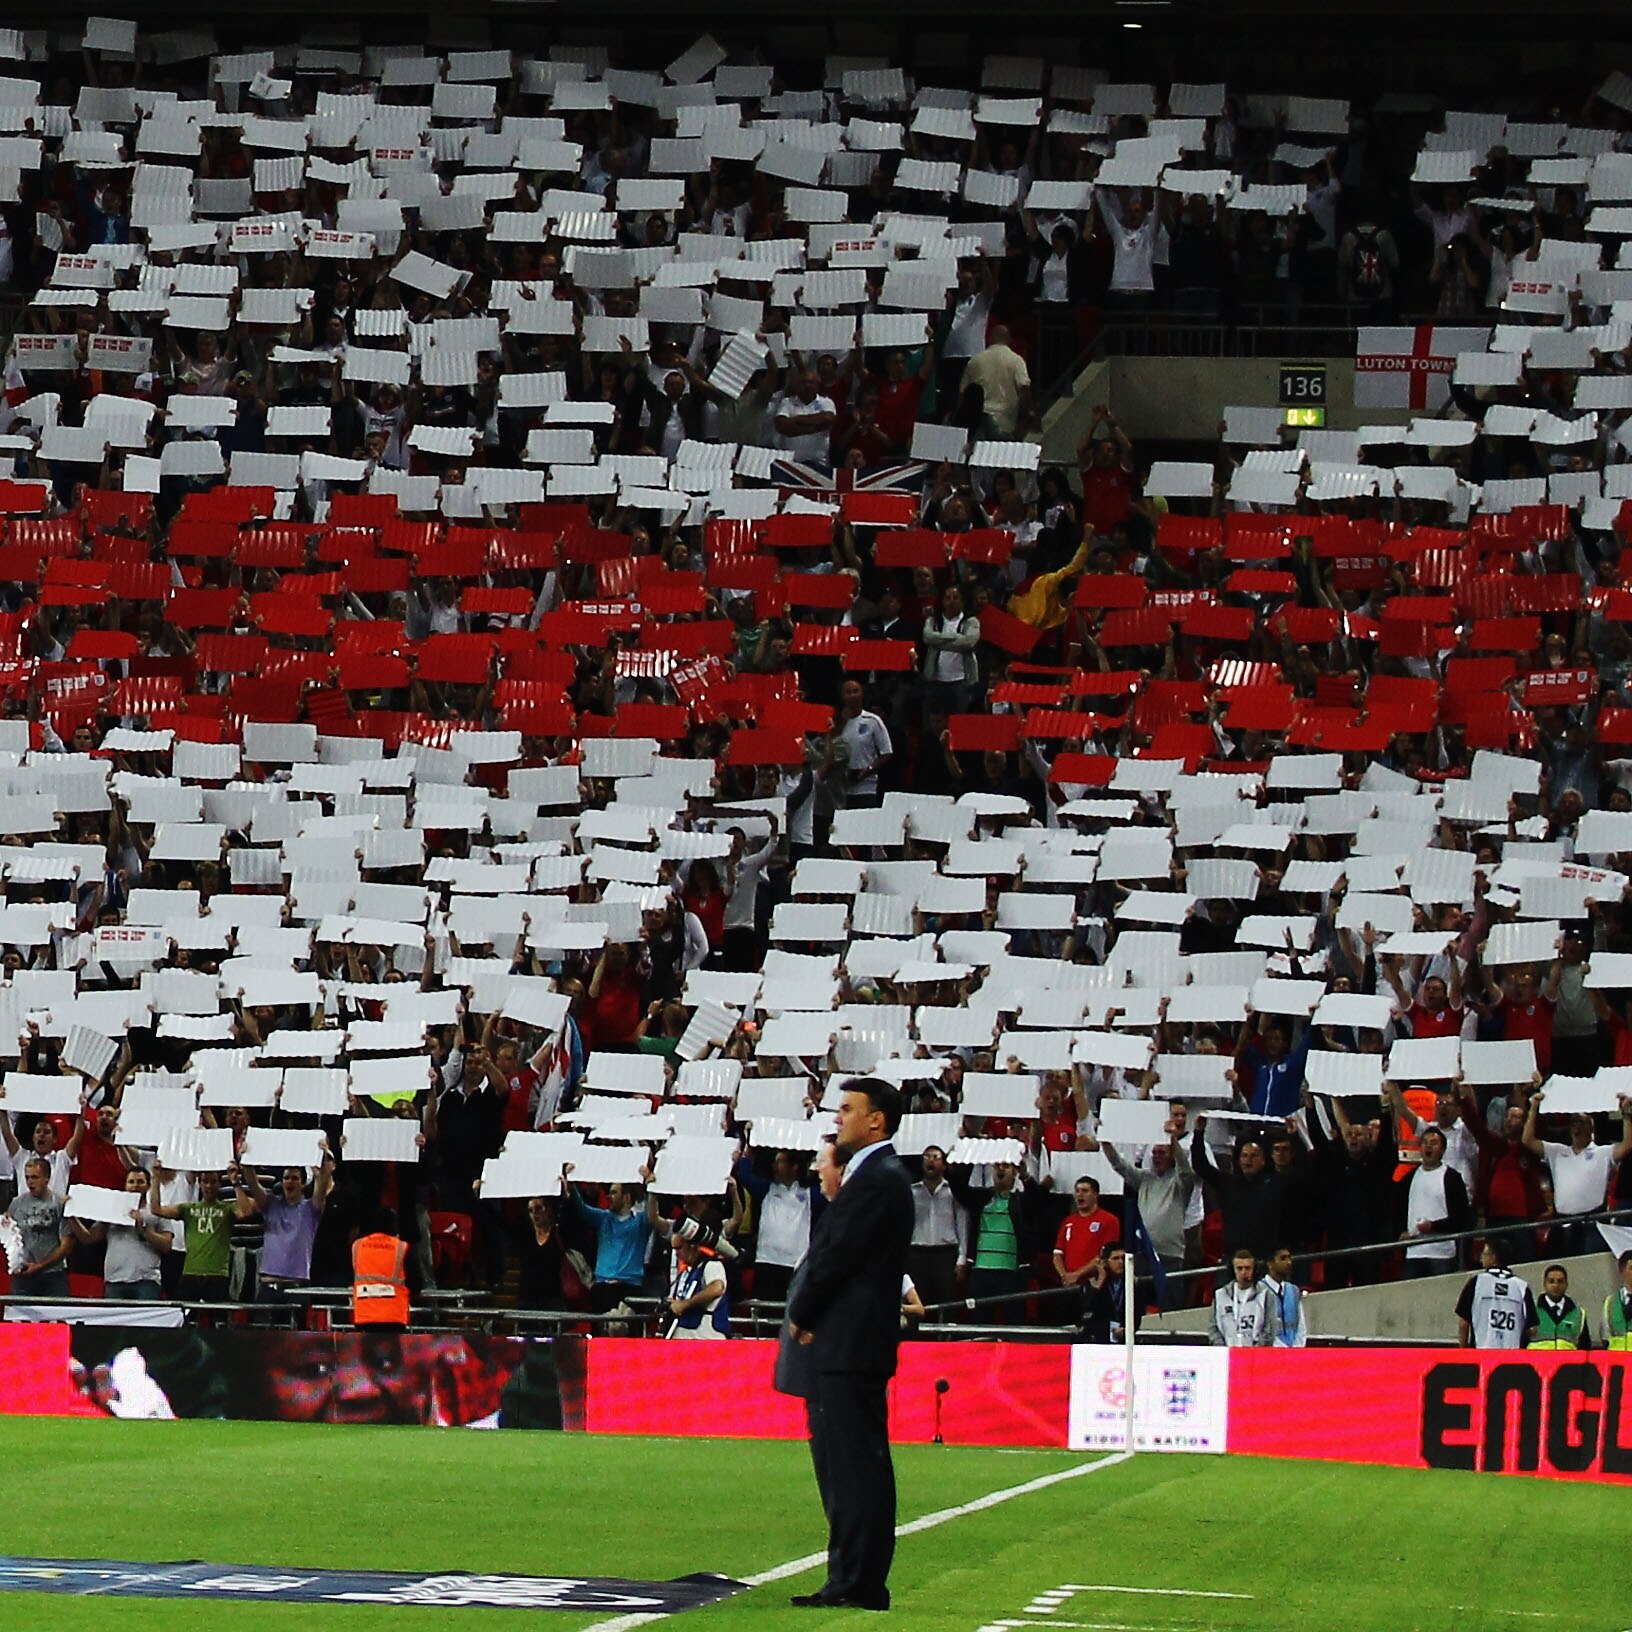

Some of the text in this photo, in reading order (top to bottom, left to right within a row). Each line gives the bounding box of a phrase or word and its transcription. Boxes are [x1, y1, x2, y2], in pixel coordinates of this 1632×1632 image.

[1356, 358, 1406, 370] LUTON
[1282, 377, 1323, 397] 136
[197, 1217, 215, 1234] CA
[1490, 1310, 1515, 1331] 526
